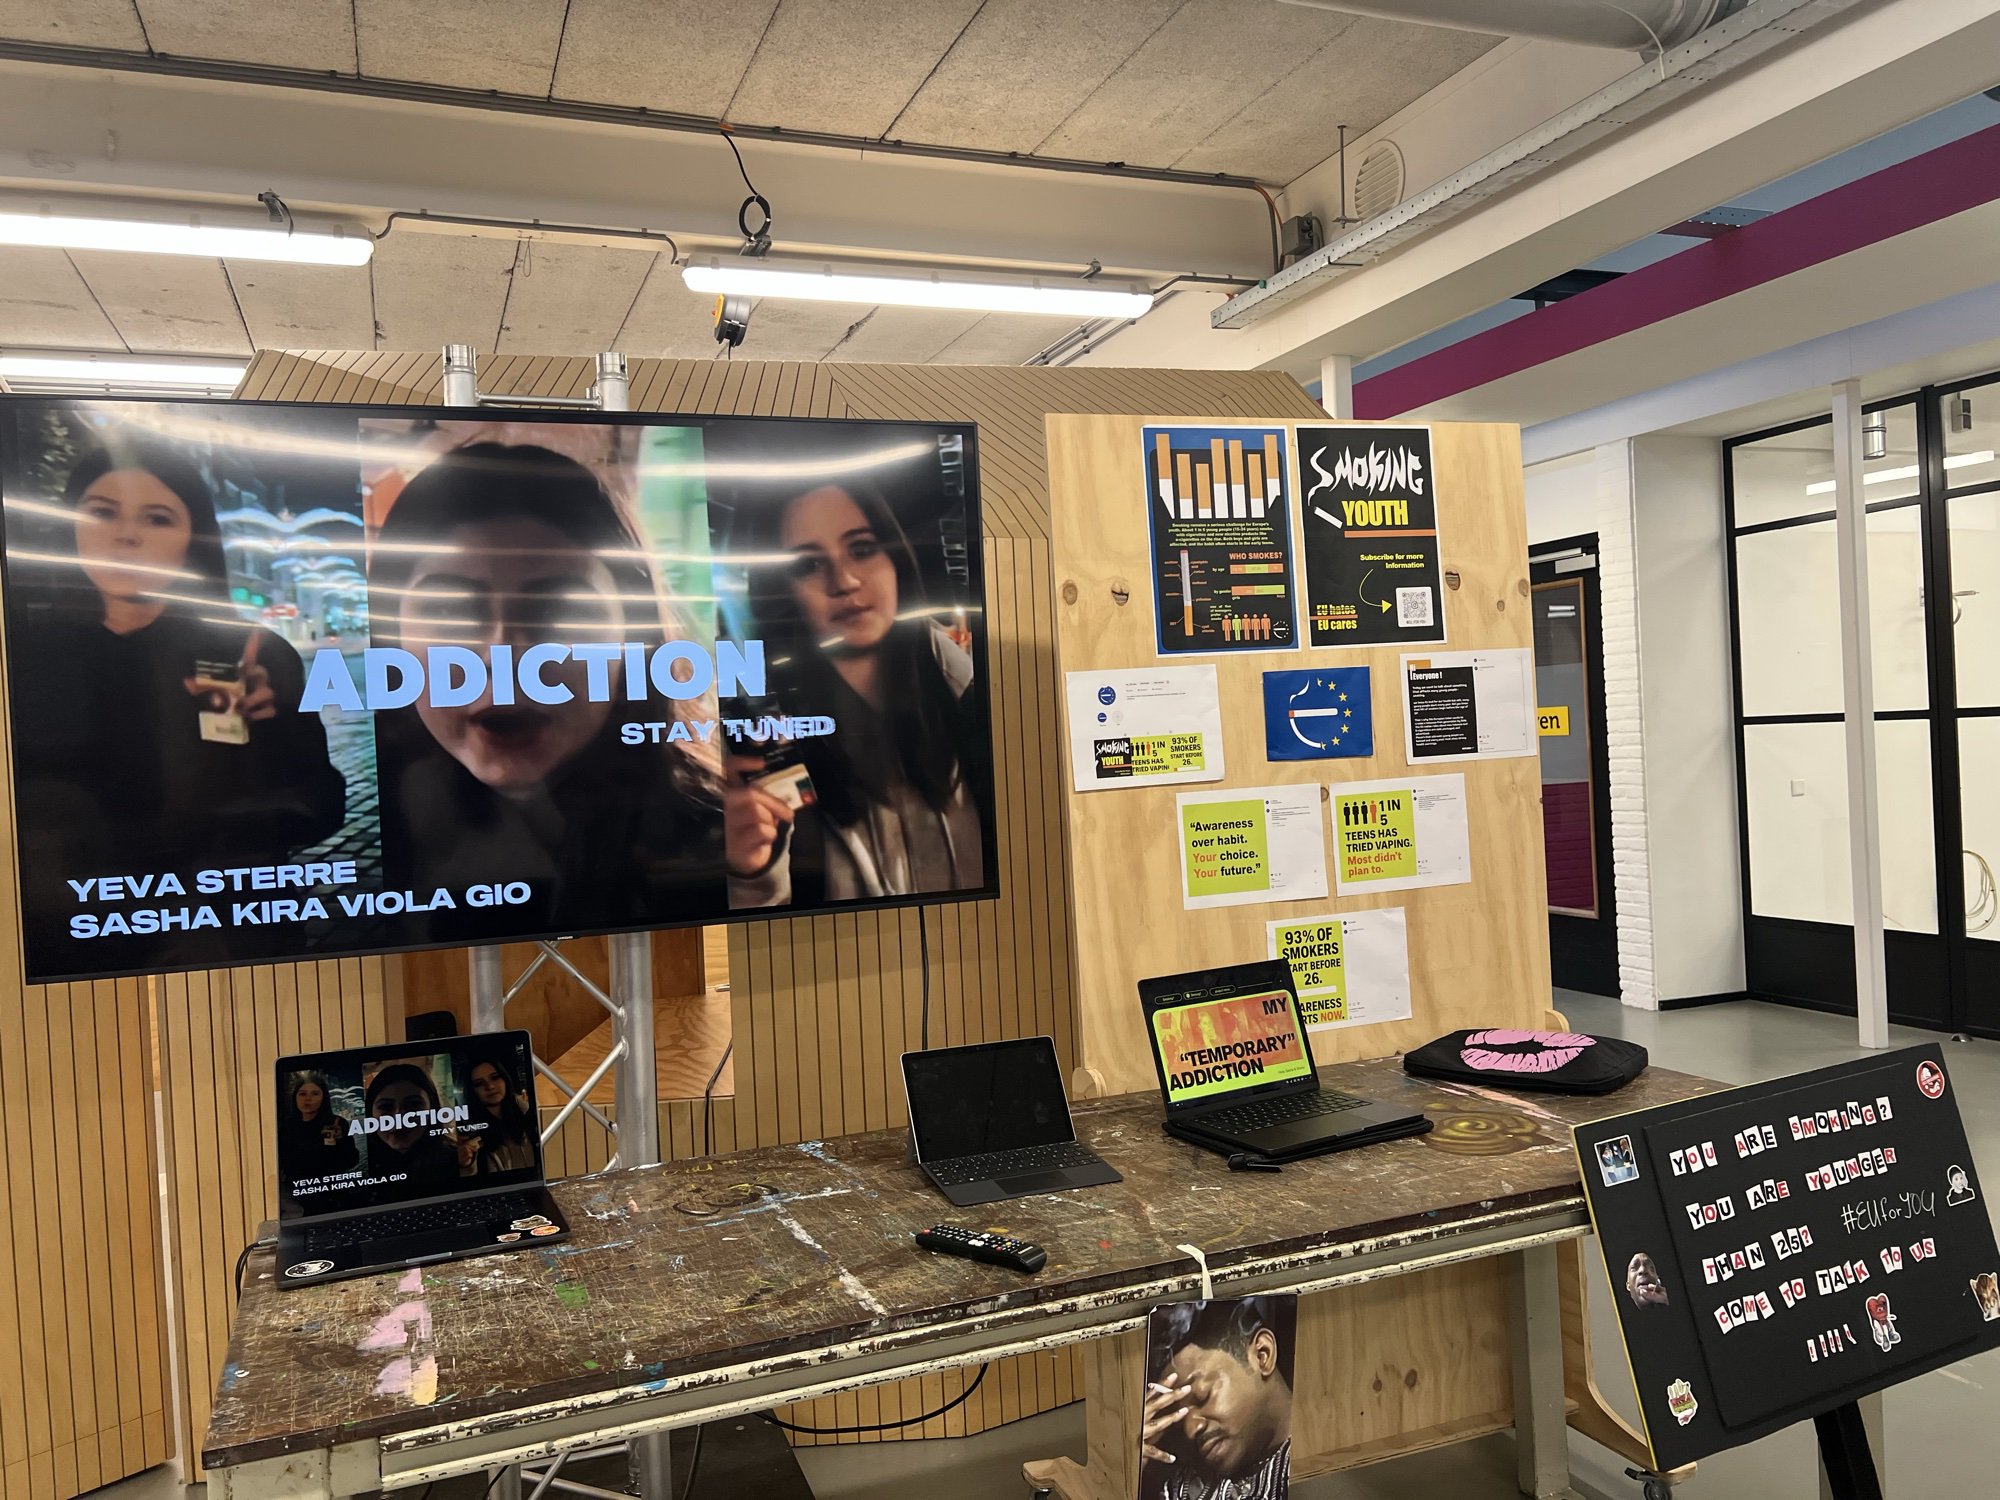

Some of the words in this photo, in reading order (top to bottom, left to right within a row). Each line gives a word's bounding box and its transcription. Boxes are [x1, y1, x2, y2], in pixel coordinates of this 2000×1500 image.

[1308, 441, 1423, 506] SMOKING
[1342, 500, 1408, 526] YOUTH
[1330, 604, 1356, 615] hates
[1318, 620, 1328, 630] EU
[1330, 620, 1357, 630] cares
[298, 640, 766, 712] ADDICTION
[620, 720, 717, 744] STAY
[720, 715, 836, 742] TUNED
[1096, 740, 1129, 756] SMOKING
[1170, 744, 1201, 752] SMOKERS
[1102, 756, 1124, 766] YOUTH
[1379, 801, 1384, 811] 1
[1388, 799, 1400, 811] IN
[1190, 820, 1253, 832] “Awareness
[1380, 814, 1387, 825] 5
[1192, 838, 1214, 848] over
[1218, 834, 1248, 845] habit.
[1345, 830, 1376, 841] TEENS
[1378, 828, 1398, 838] HAS
[1346, 842, 1373, 853] TRIED
[1375, 838, 1413, 850] VAPING.
[1193, 853, 1216, 863] Your
[1220, 850, 1258, 861] choice.
[1347, 855, 1371, 865] Most
[1374, 852, 1402, 862] didn't
[1194, 868, 1217, 879] Your
[1349, 866, 1369, 878] plan
[1372, 865, 1384, 874] to.
[67, 873, 186, 902] YEVA
[196, 860, 358, 894] STERRE
[69, 906, 222, 938] SASHA
[233, 899, 329, 926] KIRA
[337, 888, 456, 917] VIOLA
[465, 881, 531, 906] GIO
[1285, 929, 1314, 945] 93%
[1317, 927, 1333, 941] OF
[1282, 942, 1339, 960] SMOKERS
[1310, 958, 1341, 970] BEFORE
[1304, 972, 1322, 985] 26.
[1262, 997, 1287, 1015] MY
[1300, 998, 1342, 1012] ARENESS
[1320, 1010, 1344, 1021] NOW.
[1170, 1058, 1264, 1091] ADDICTION
[348, 1105, 469, 1136] ADDICTION
[429, 1126, 454, 1136] STAY
[457, 1123, 489, 1132] TUNED
[1671, 1145, 1716, 1174] YOU
[1736, 1128, 1776, 1155] ARE
[293, 1178, 320, 1188] YEVA
[322, 1171, 362, 1183] STERRE
[293, 1185, 329, 1196] SASHA
[331, 1181, 355, 1191] KIRA
[357, 1176, 387, 1186] VIOLA
[390, 1173, 407, 1182] GIO
[1688, 1199, 1733, 1227] YOU
[1749, 1180, 1789, 1208] ARE
[1807, 1148, 1896, 1190] YOUNGER
[1704, 1245, 1764, 1281] THAN
[1774, 1227, 1811, 1258] 25?
[1716, 1294, 1771, 1329] COME
[1781, 1280, 1805, 1305] TO
[1817, 1262, 1868, 1291] TALK
[1881, 1248, 1901, 1269] TO
[1910, 1240, 1935, 1261] US
